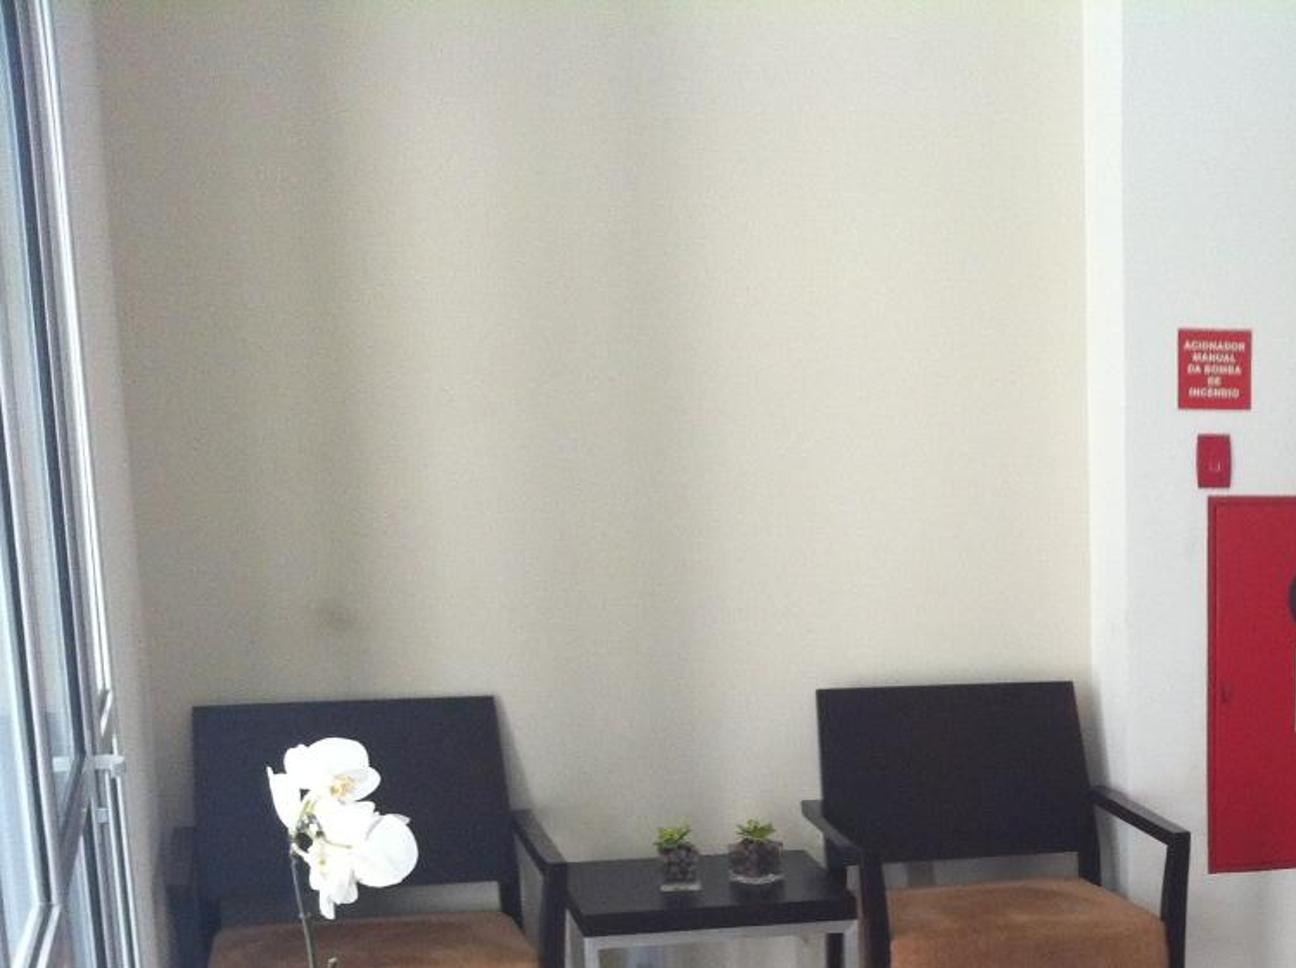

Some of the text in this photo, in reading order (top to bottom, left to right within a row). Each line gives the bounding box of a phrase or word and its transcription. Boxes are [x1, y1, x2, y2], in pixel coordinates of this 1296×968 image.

[1184, 340, 1245, 352] ACIONADOR
[1192, 351, 1236, 363] MANUAL
[1187, 363, 1242, 375] DA BOMBA
